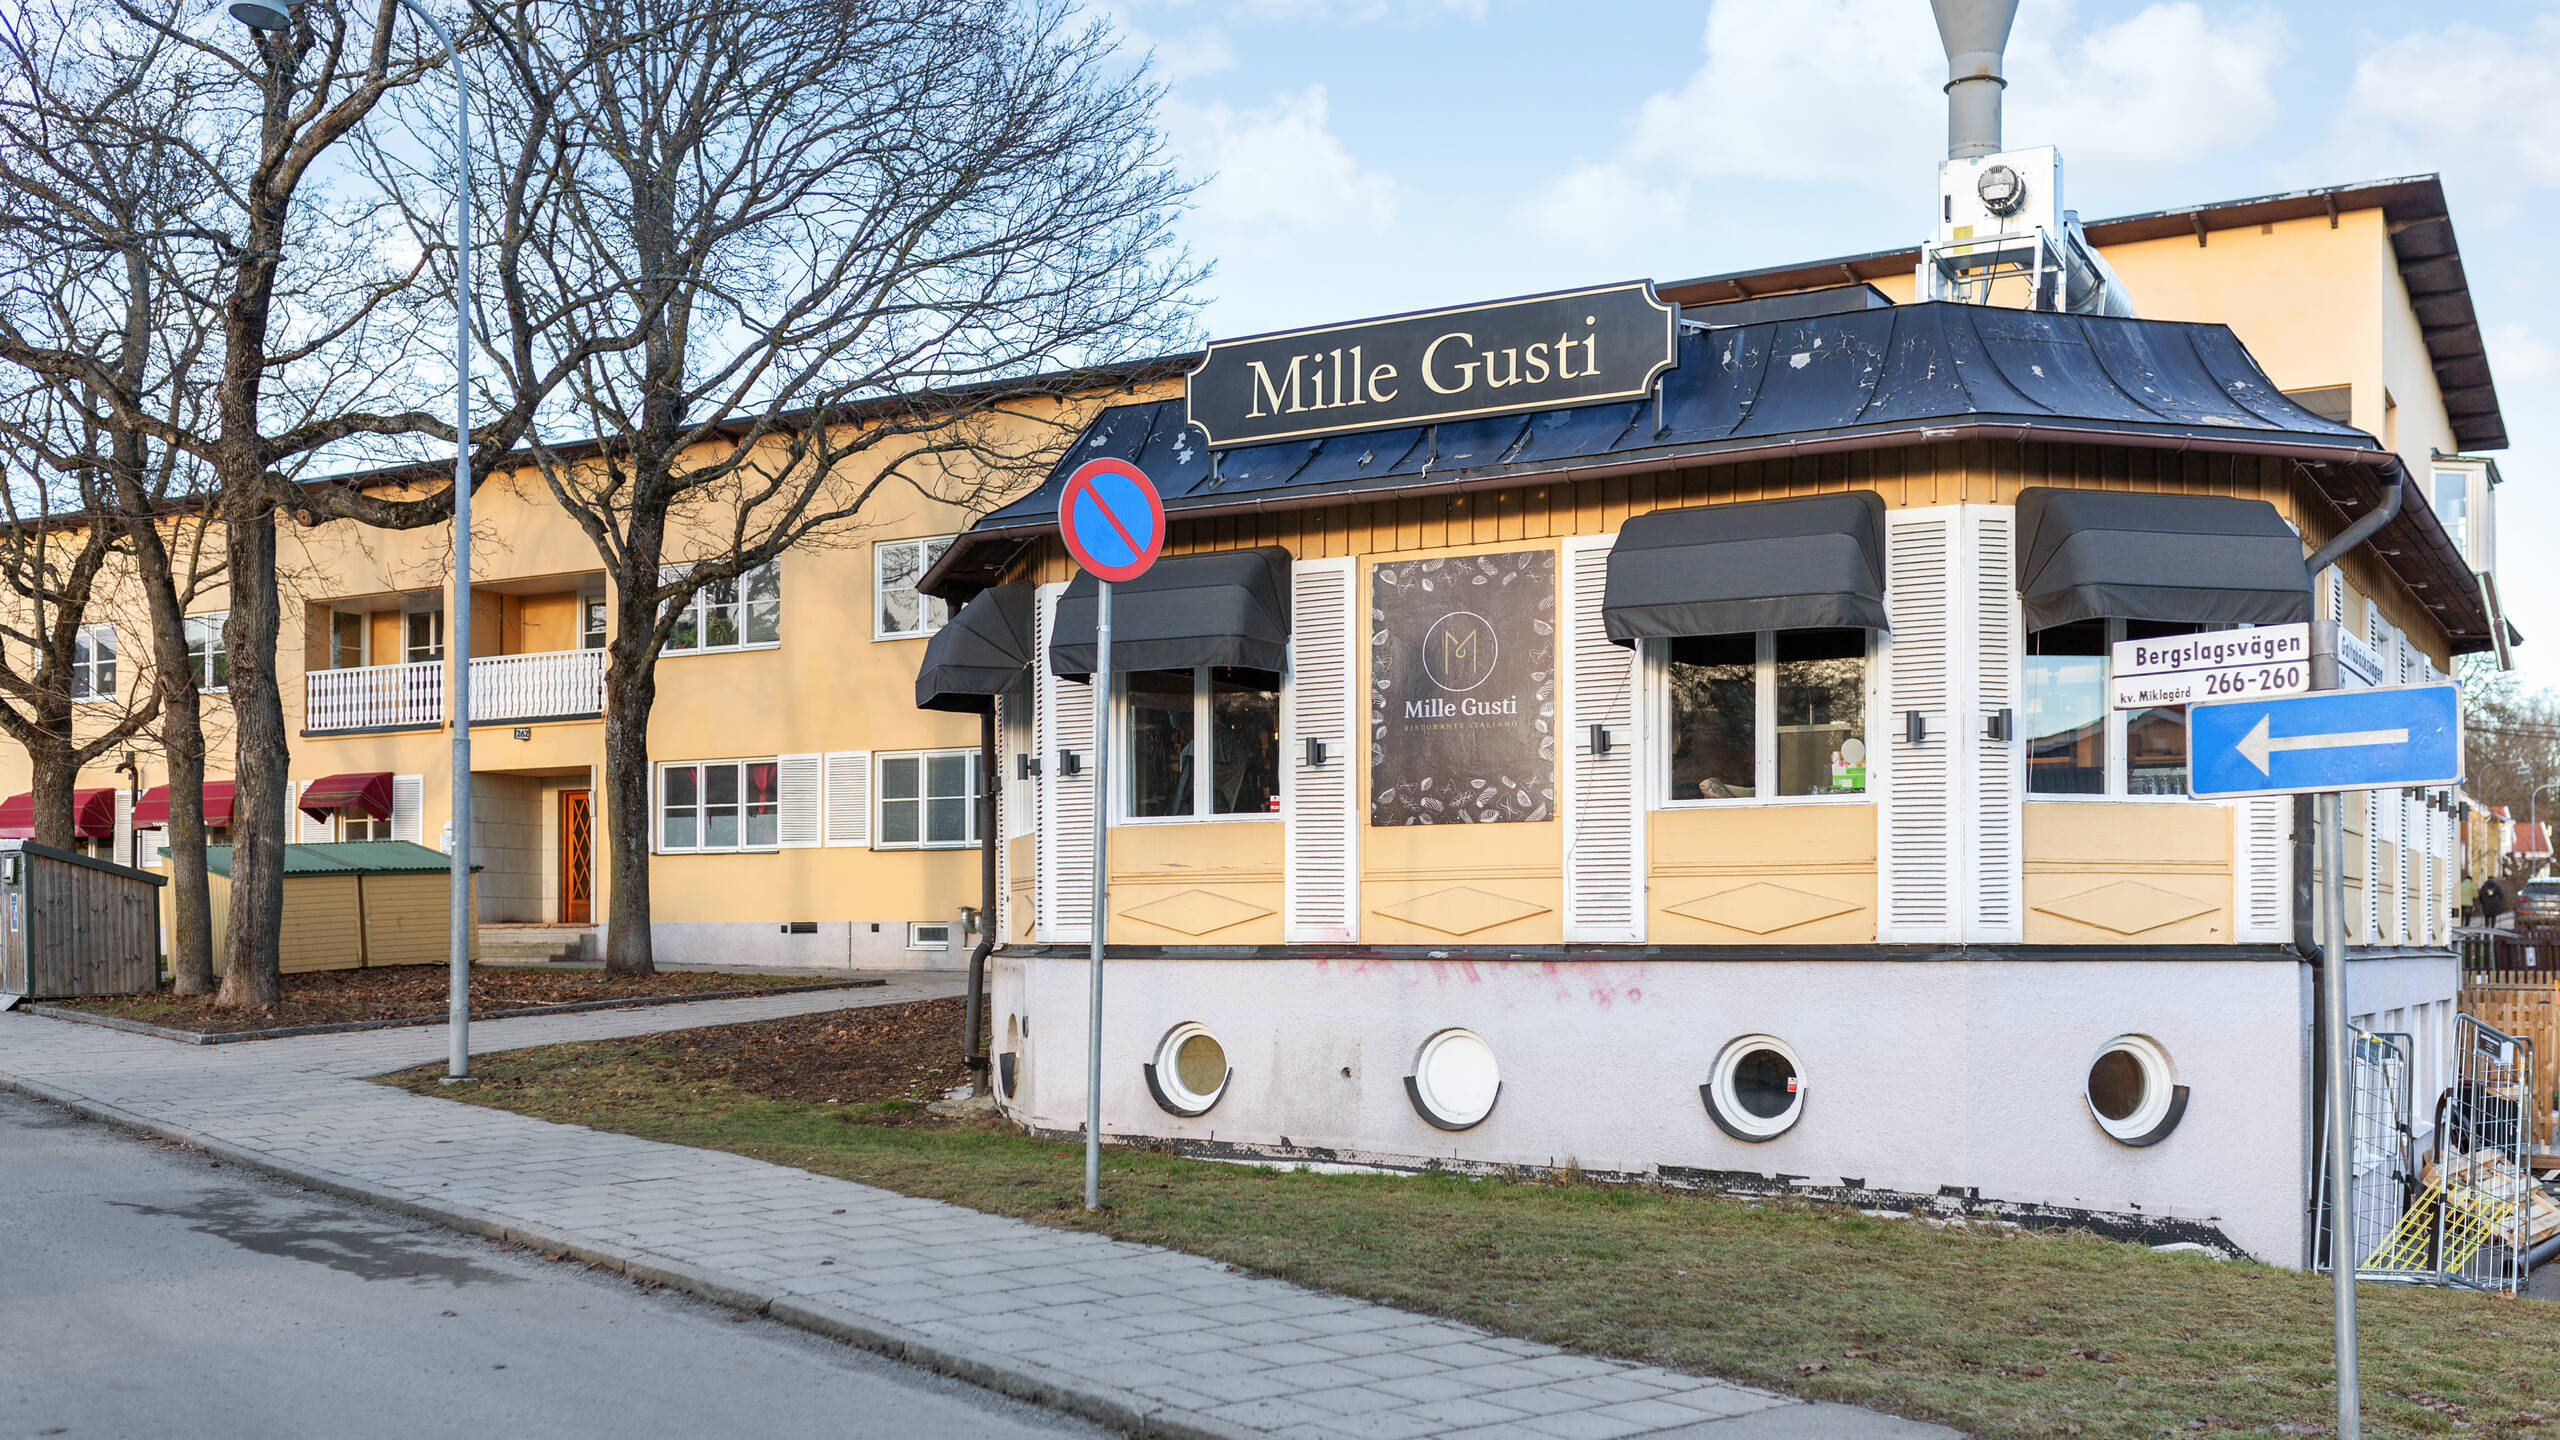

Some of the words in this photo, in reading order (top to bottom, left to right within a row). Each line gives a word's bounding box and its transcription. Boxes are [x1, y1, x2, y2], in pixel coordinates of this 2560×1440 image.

[1245, 345, 1399, 419] Mille
[1421, 315, 1601, 395] Gusti
[2136, 635, 2301, 668] Bergslagsvägen
[2206, 667, 2300, 696] 266-260
[1404, 698, 1456, 719] Mille
[1461, 695, 1518, 716] Gusti
[2120, 692, 2136, 704] kv.
[2139, 686, 2191, 702] Miklagård
[1404, 721, 1464, 731] RISTORANTE
[1469, 720, 1518, 729] ITALIANO
